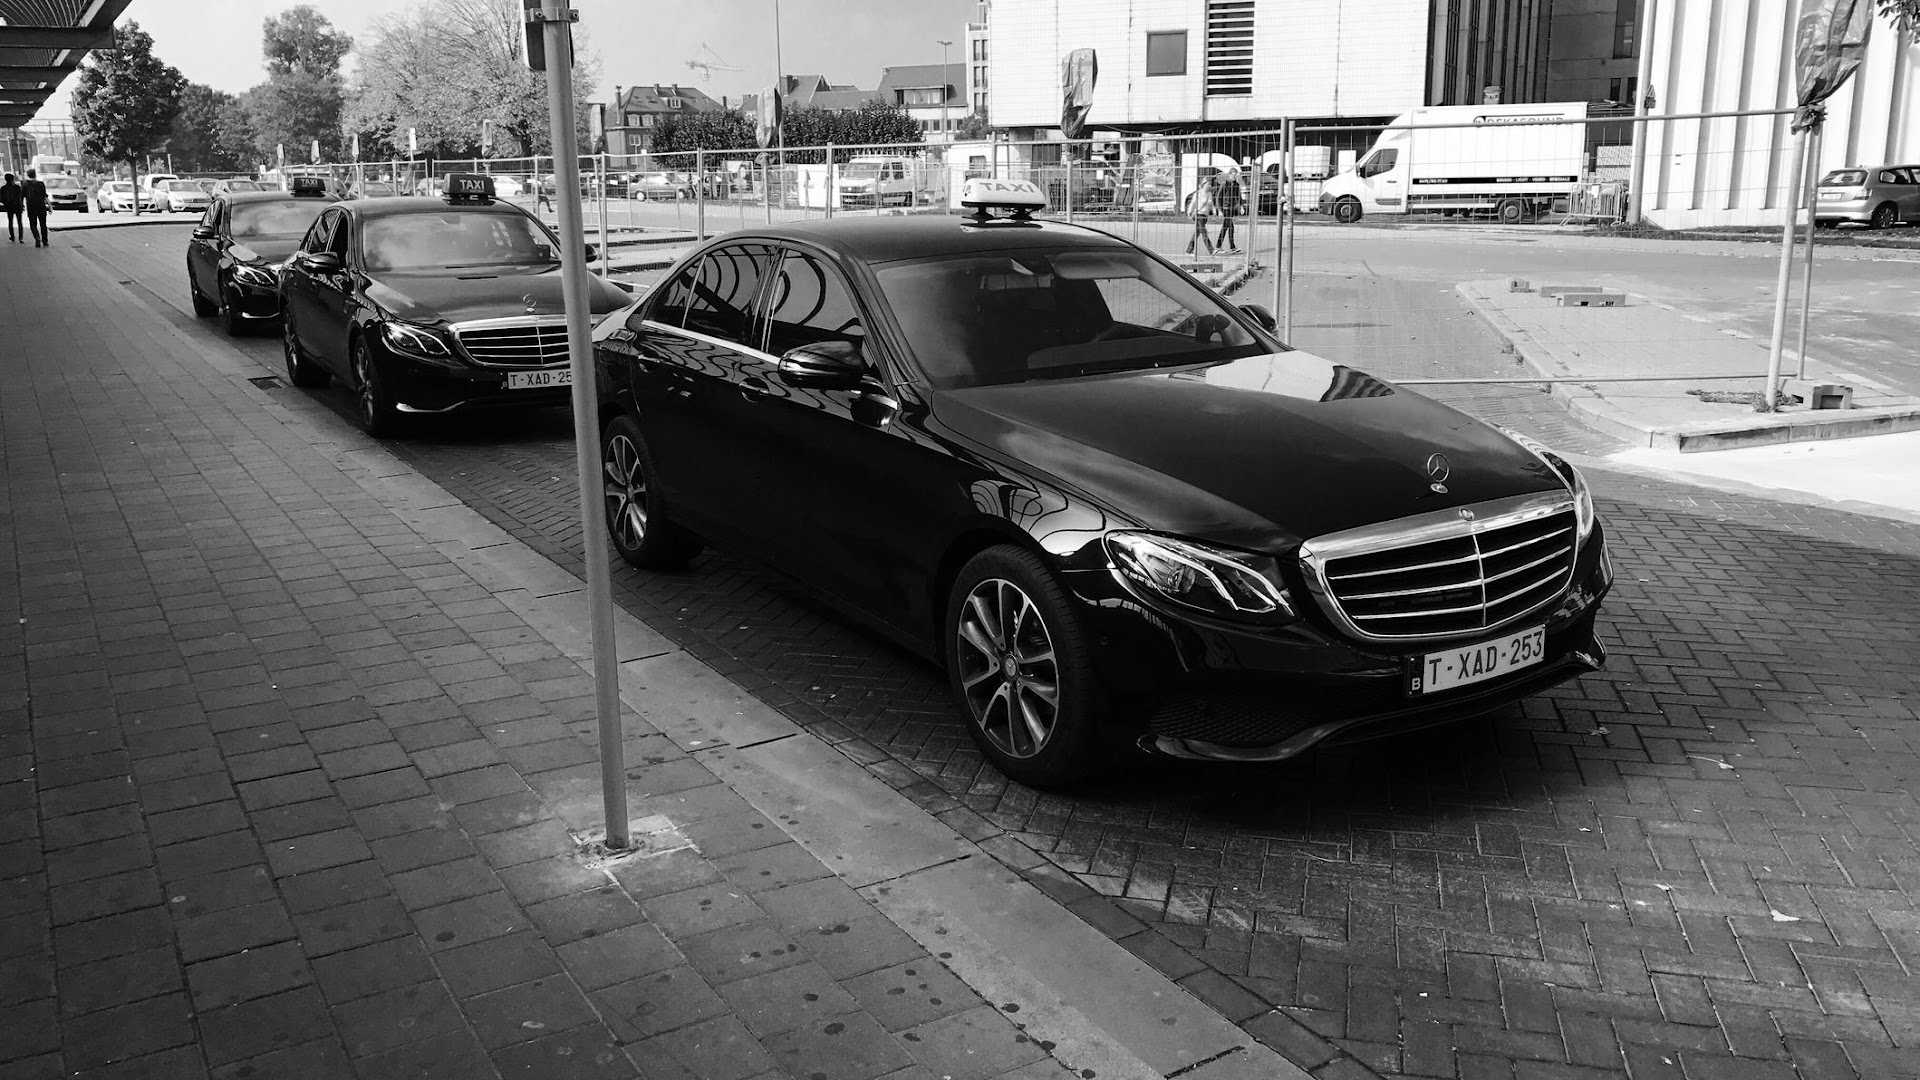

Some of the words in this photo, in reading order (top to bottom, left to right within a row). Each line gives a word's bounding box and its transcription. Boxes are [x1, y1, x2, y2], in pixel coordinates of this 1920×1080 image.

[300, 178, 318, 187] TAXI
[459, 179, 485, 190] TAXI
[979, 182, 1035, 193] TAXI
[510, 371, 572, 387] T-XAD-25
[1429, 630, 1543, 686] T-XAD-253
[1412, 677, 1421, 691] B
